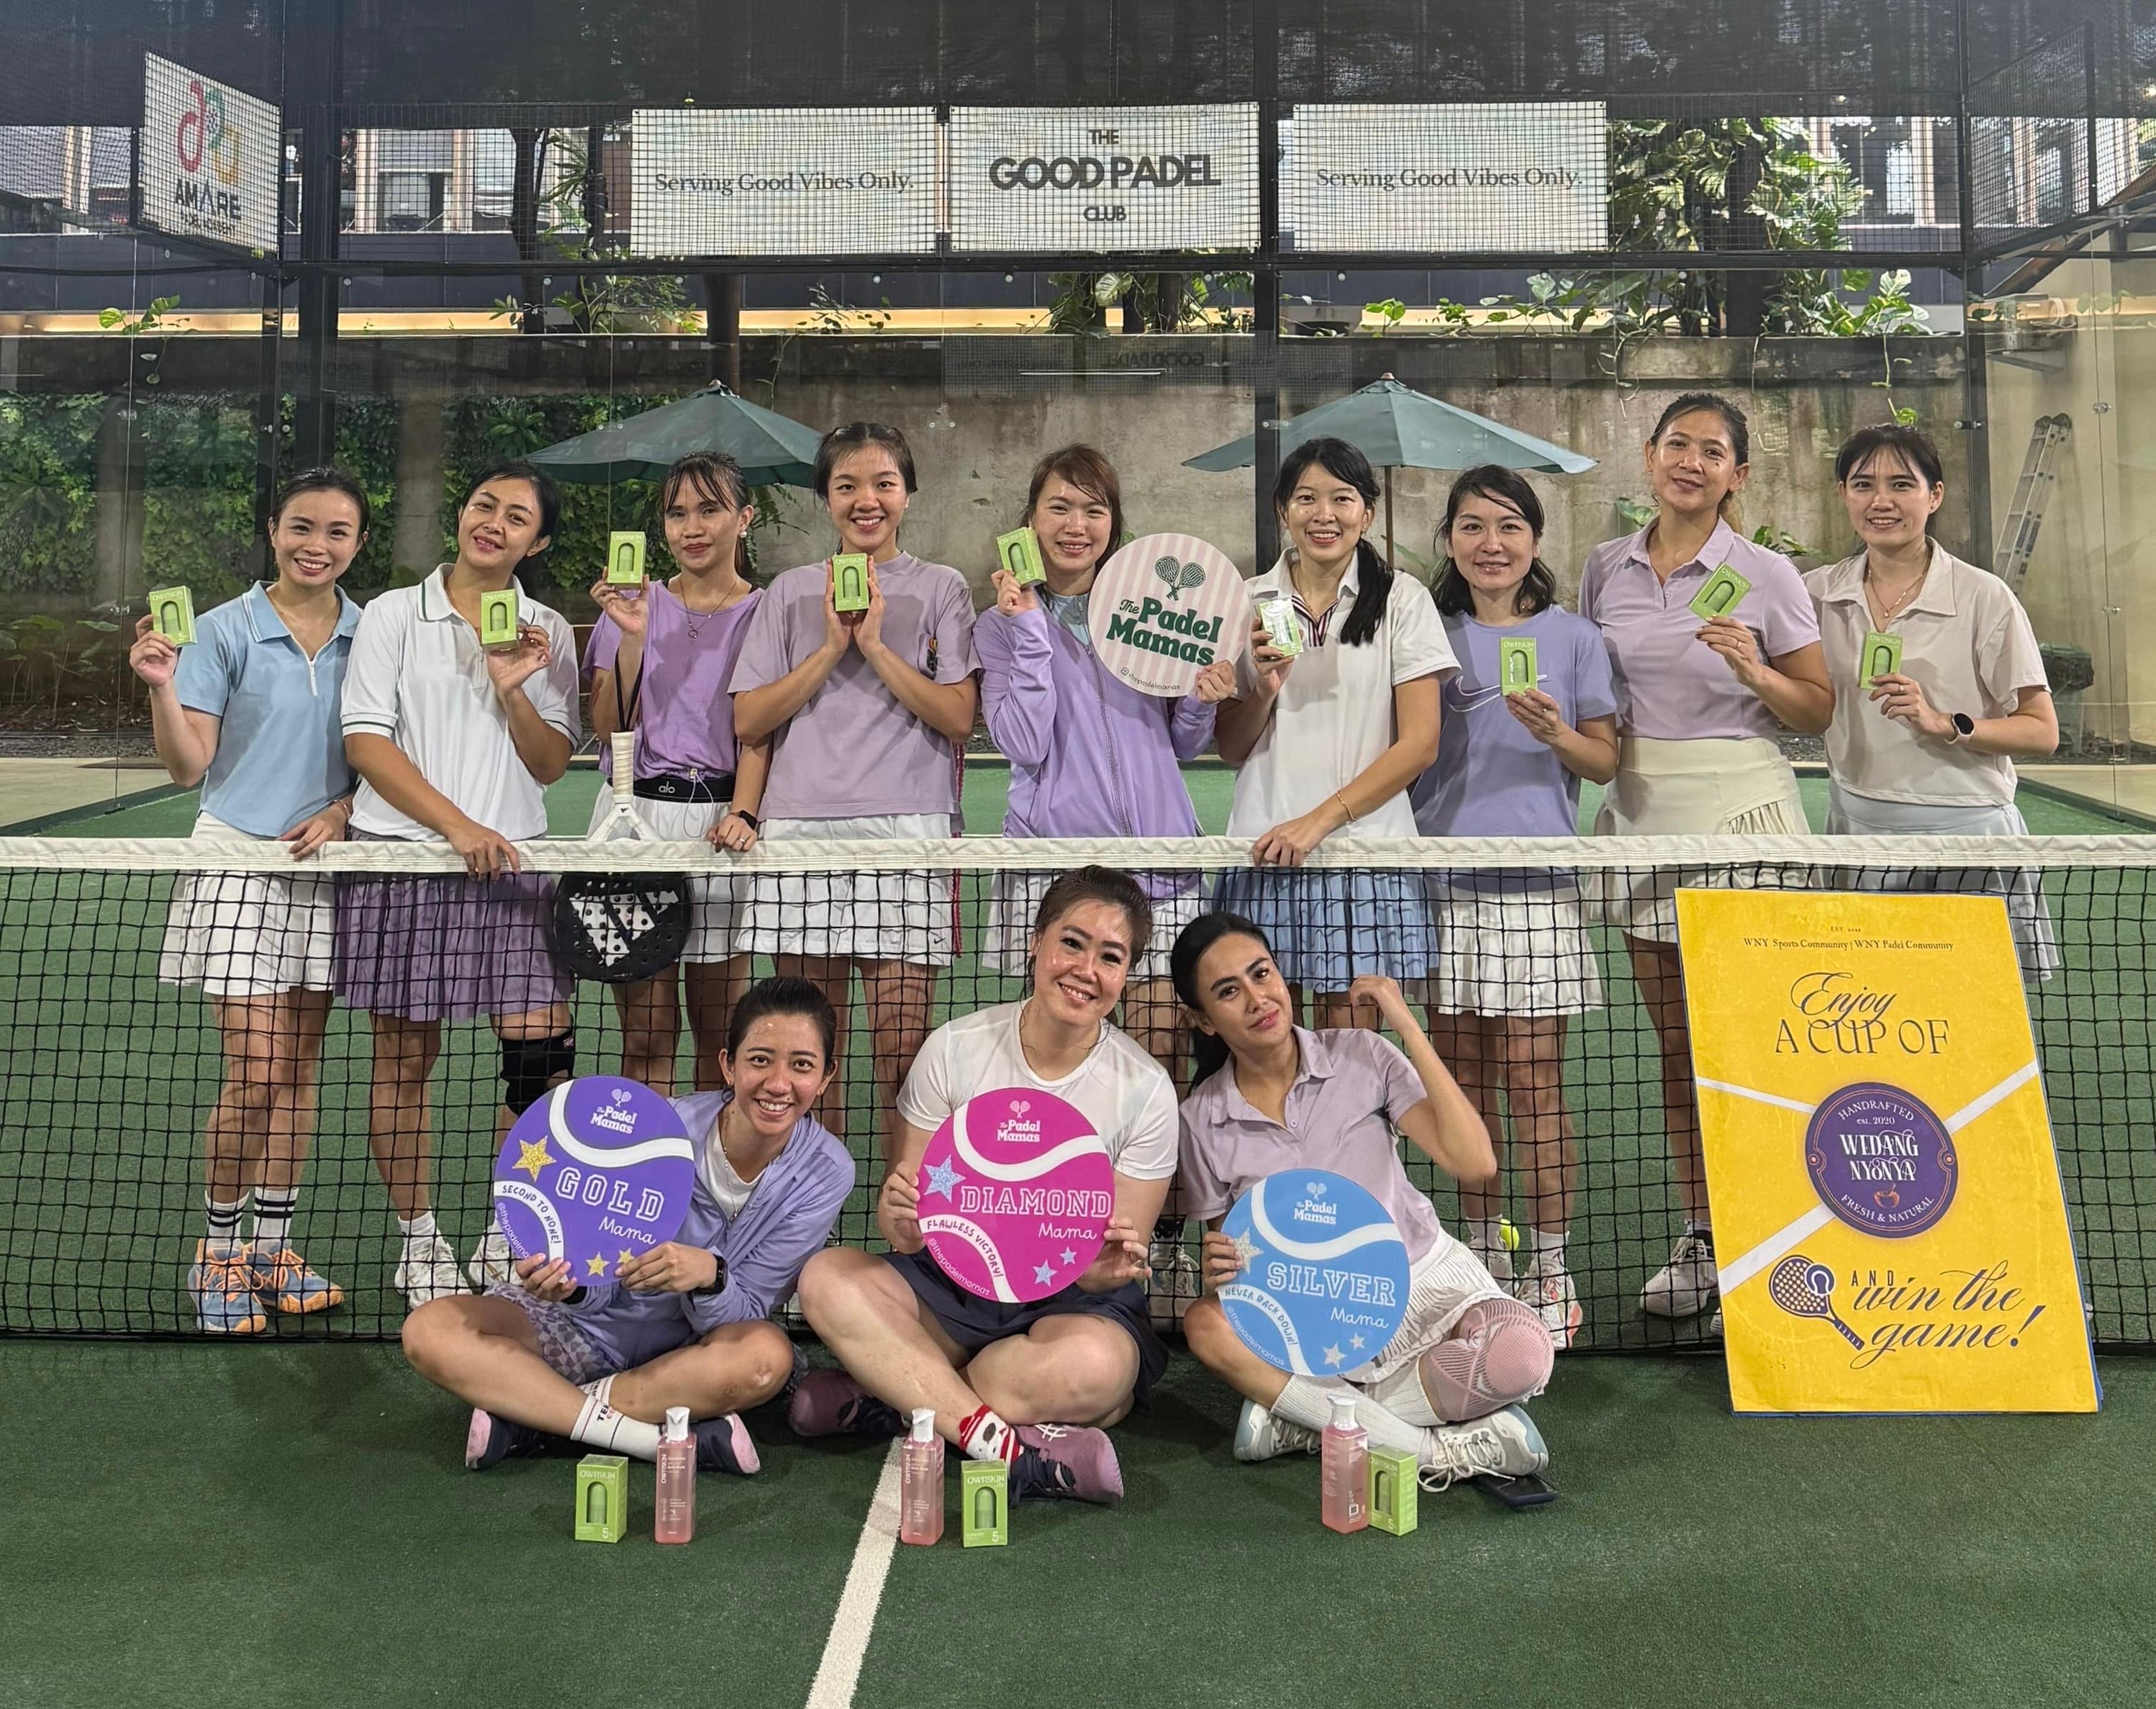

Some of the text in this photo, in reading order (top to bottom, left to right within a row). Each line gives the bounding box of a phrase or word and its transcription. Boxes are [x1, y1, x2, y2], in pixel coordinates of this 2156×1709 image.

[1088, 129, 1120, 145] THE
[655, 170, 915, 196] Serving Good Vibes Only.
[989, 154, 1222, 191] GOOD PADEL
[1316, 166, 1583, 191] Serving Good Vibes Only.
[175, 178, 242, 221] AMARE
[1083, 205, 1127, 222] CLUB
[1119, 597, 1224, 643] The Padel
[1106, 613, 1215, 666] Mamas
[658, 781, 676, 794] alo
[1744, 937, 1769, 948] WNY
[1772, 938, 1799, 950] Sports
[1800, 938, 1848, 951] Community
[1854, 939, 1880, 949] WNY
[1883, 940, 1904, 949] Padel
[1906, 940, 1954, 952] Community
[1790, 971, 1899, 1030] Enjoy
[1775, 1018, 1949, 1054] A CUP OF
[590, 1112, 634, 1134] Mamas
[603, 1105, 638, 1125] Padel
[1838, 1100, 1914, 1121] HANDRAFTED
[997, 1129, 1041, 1143] Mamas
[1007, 1119, 1041, 1133] Padel
[1839, 1129, 1919, 1156] WEDANG
[1849, 1156, 1917, 1182] NYONYA
[555, 1166, 665, 1223] GOLD
[959, 1185, 1112, 1219] DIAMOND
[1304, 1199, 1337, 1215] Padel
[502, 1184, 562, 1245] SECOND TO NONE!
[1294, 1207, 1337, 1225] Mamas
[1841, 1194, 1934, 1223] FRESH & NATURAL
[598, 1216, 657, 1246] Mama
[1038, 1222, 1097, 1240] Mama
[927, 1219, 1005, 1278] FLAWLESS VICTORY!
[1267, 1261, 1396, 1307] SILVER
[1851, 1269, 1894, 1287] AND
[1853, 1259, 2026, 1312] win the
[1225, 1287, 1299, 1346] NEVER BACK DOWN!
[1331, 1306, 1390, 1329] Mama
[1849, 1305, 2047, 1370] game!
